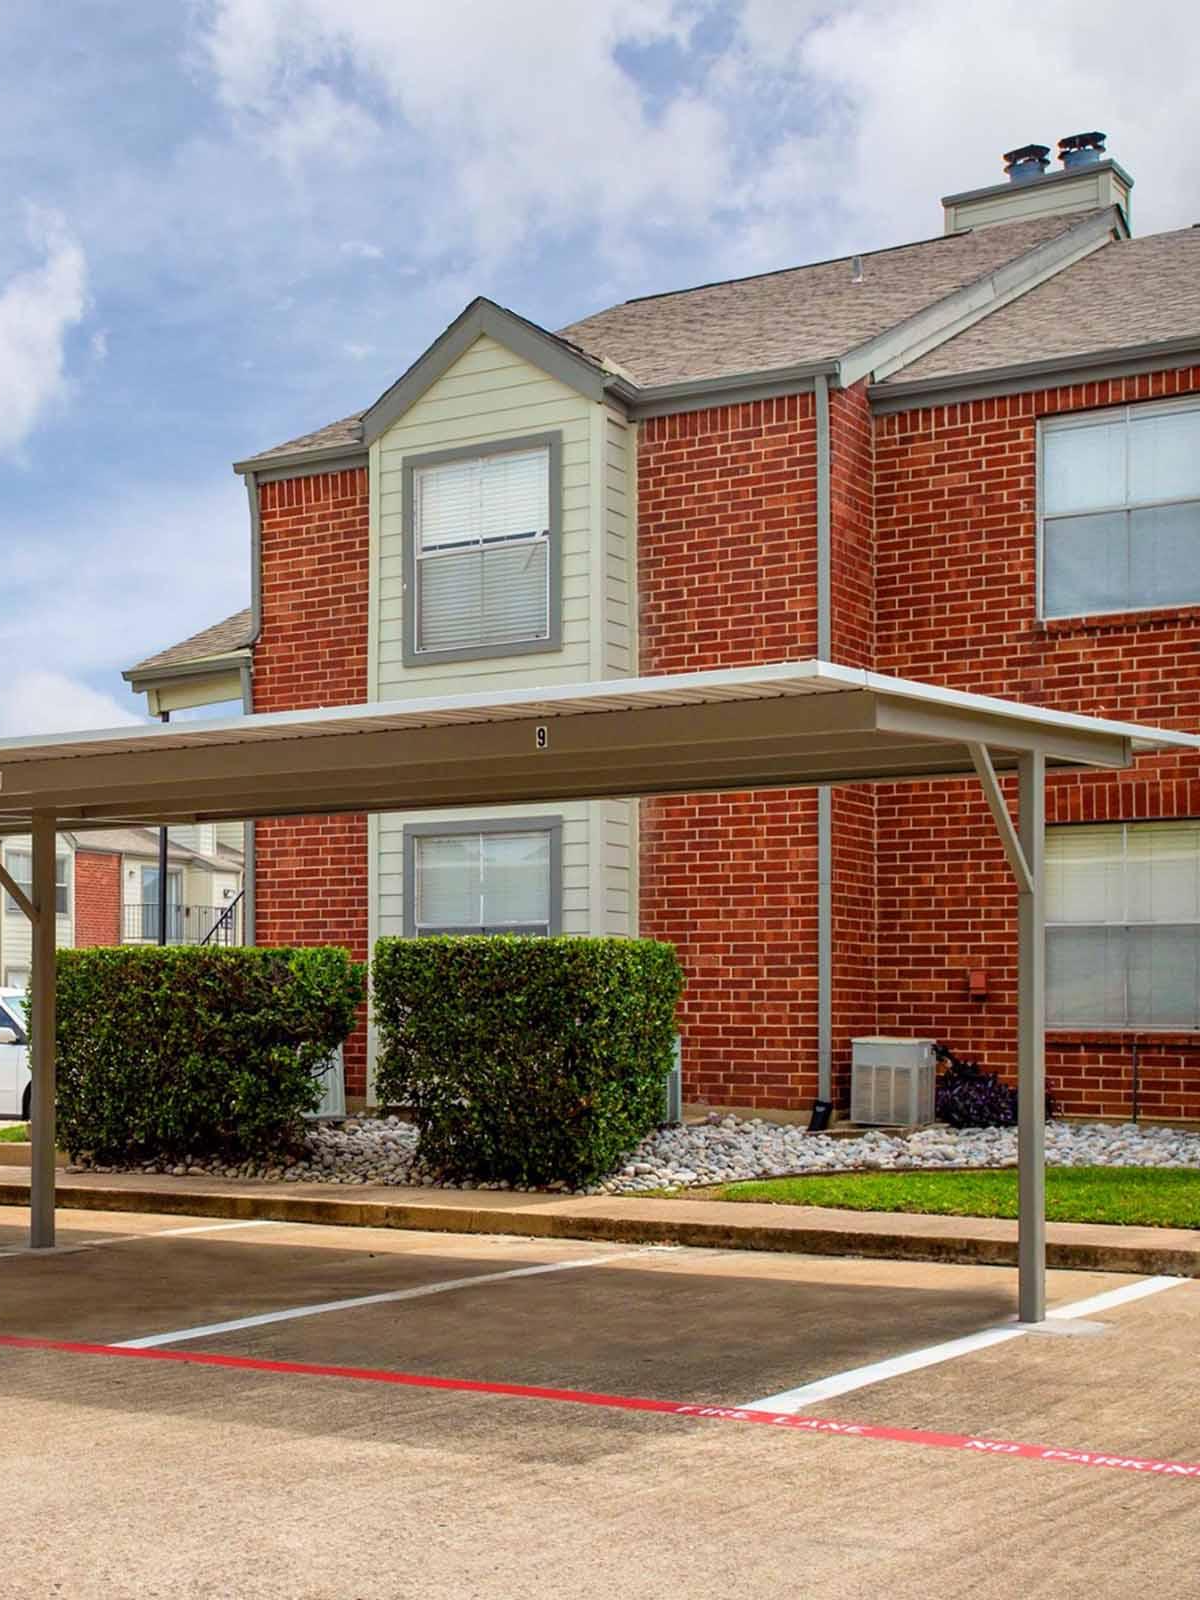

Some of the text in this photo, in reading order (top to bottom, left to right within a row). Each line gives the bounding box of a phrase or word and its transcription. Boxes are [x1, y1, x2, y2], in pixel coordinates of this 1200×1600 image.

[537, 727, 546, 747] 9
[675, 1405, 1200, 1475] FIRE LANE NO PARKIN
